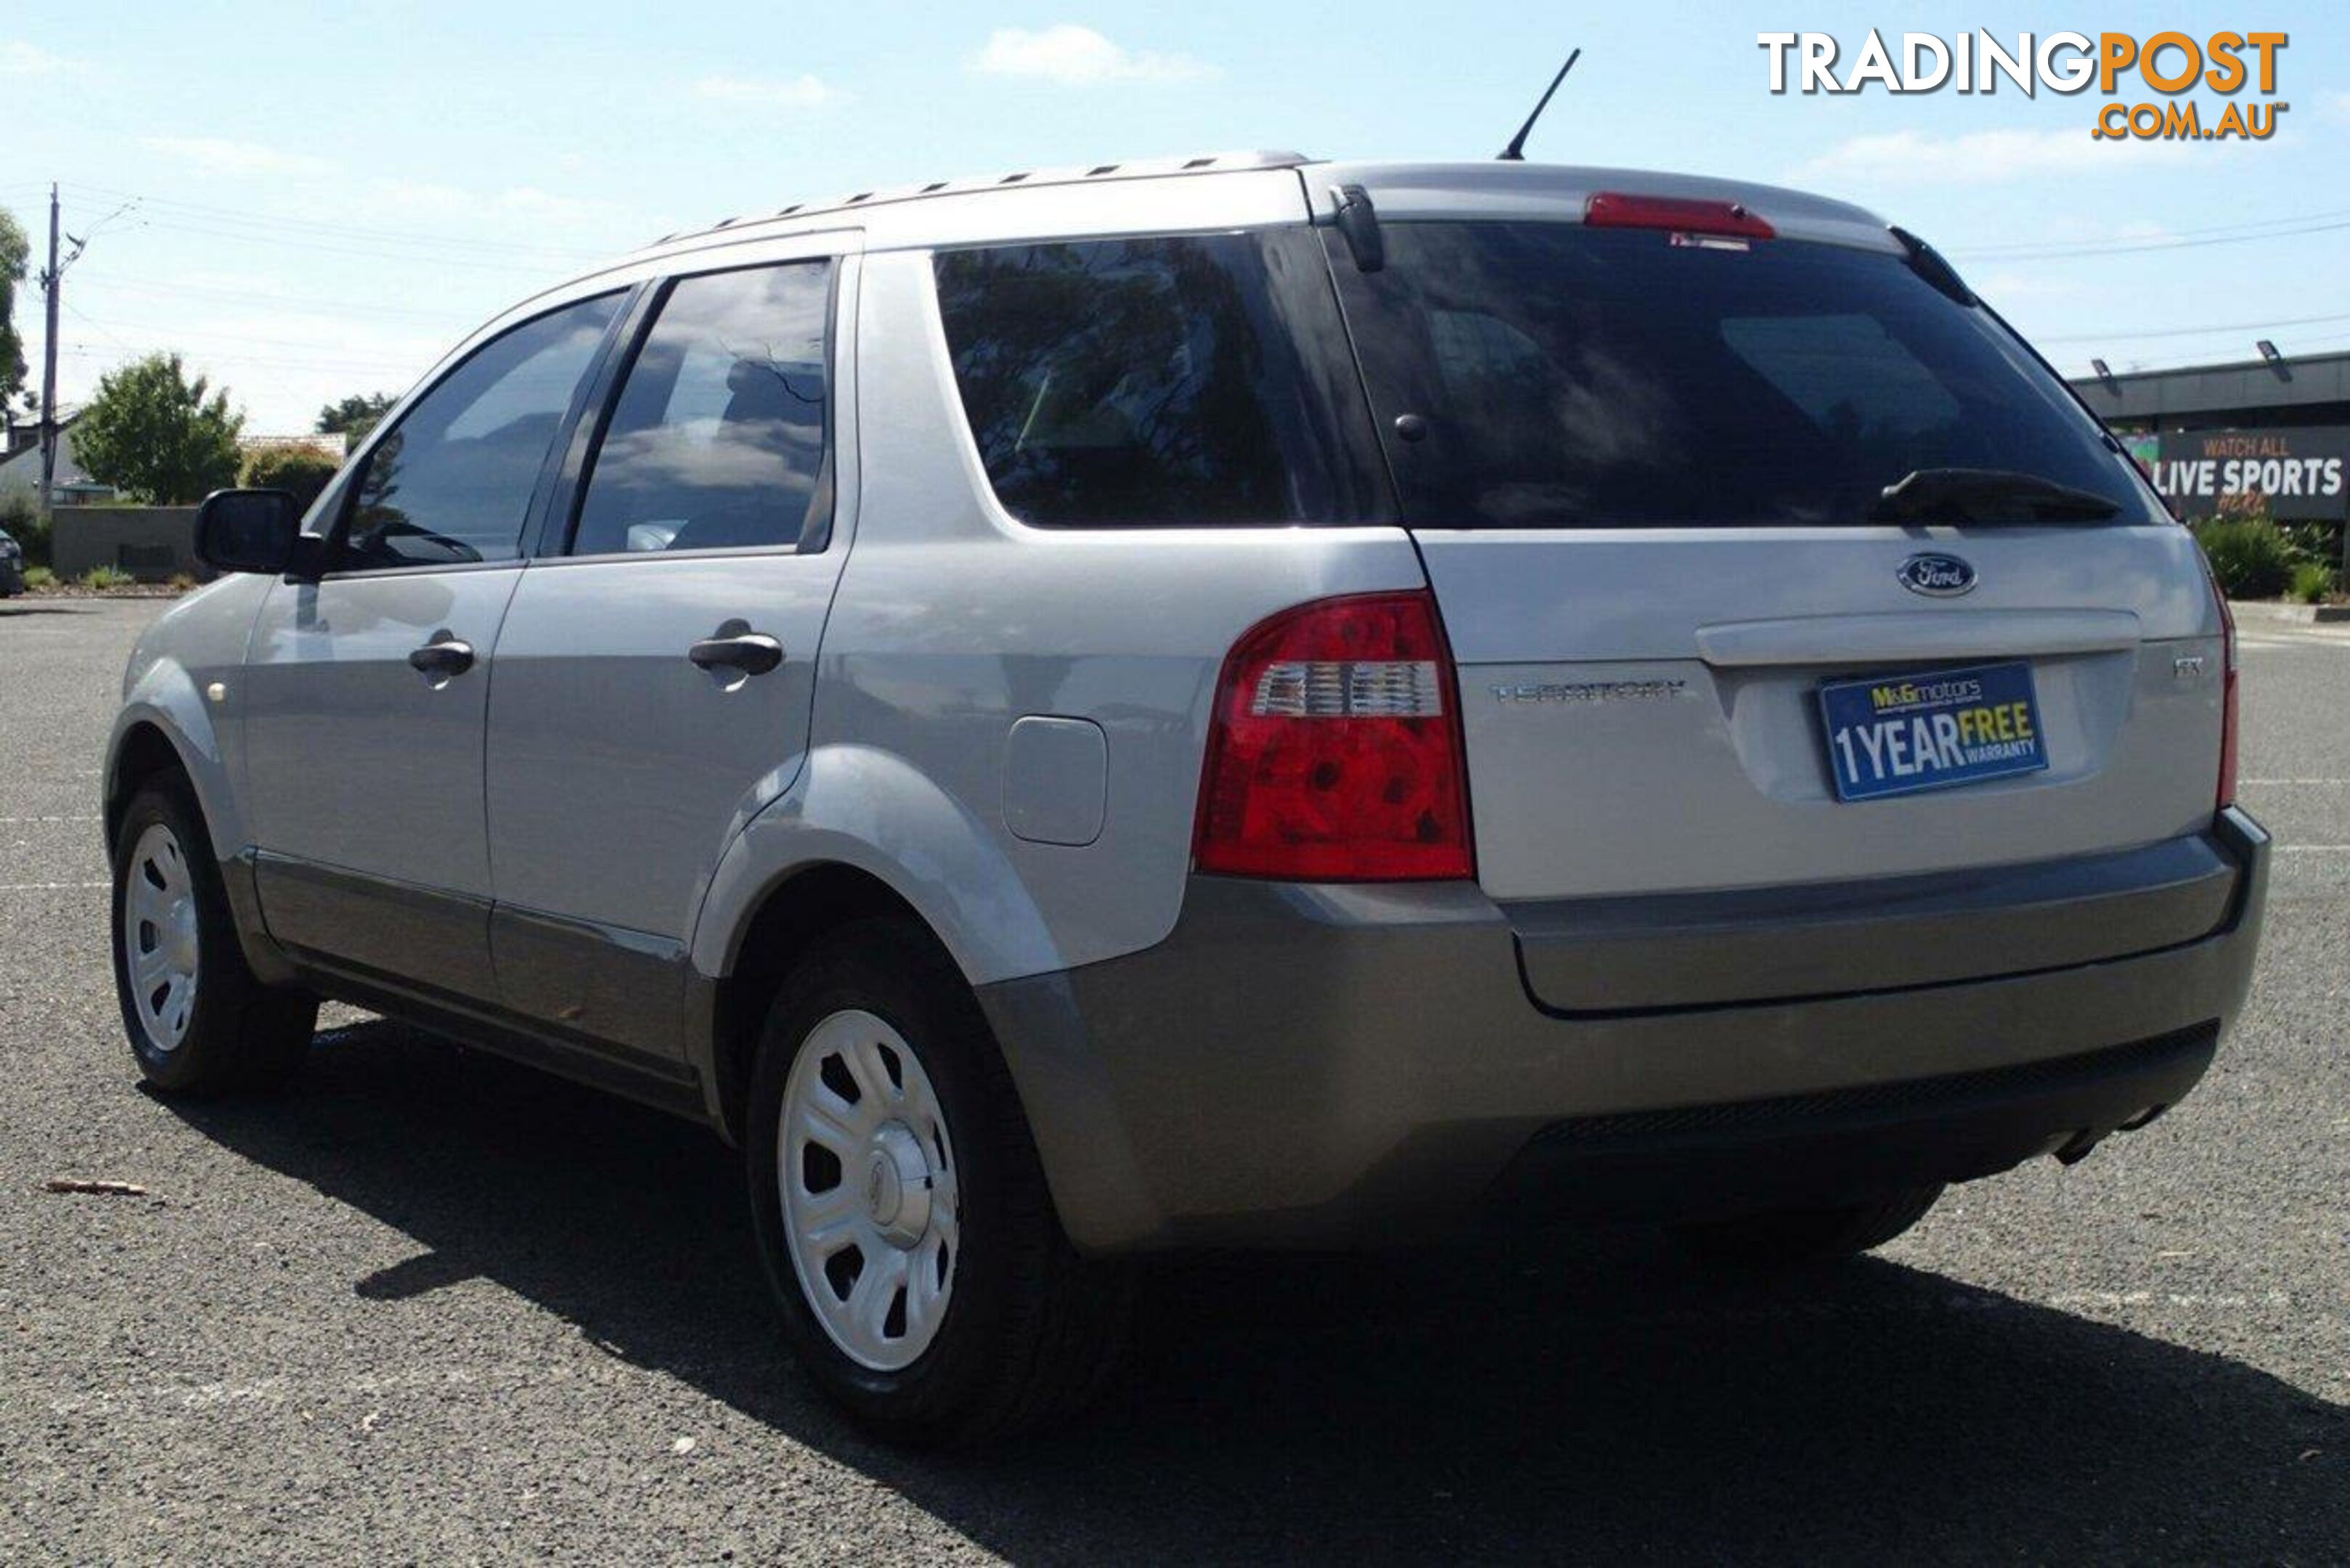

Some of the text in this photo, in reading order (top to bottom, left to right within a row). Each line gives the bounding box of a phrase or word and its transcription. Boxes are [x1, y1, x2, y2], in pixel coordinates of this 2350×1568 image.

[2204, 438, 2288, 457] WATCH ALL
[2153, 458, 2342, 496] LIVE SPORTS
[1917, 560, 1964, 586] Ford
[1957, 701, 2033, 746] FREE
[1835, 727, 1859, 783] 1
[1966, 738, 2035, 763] WARRANTY
